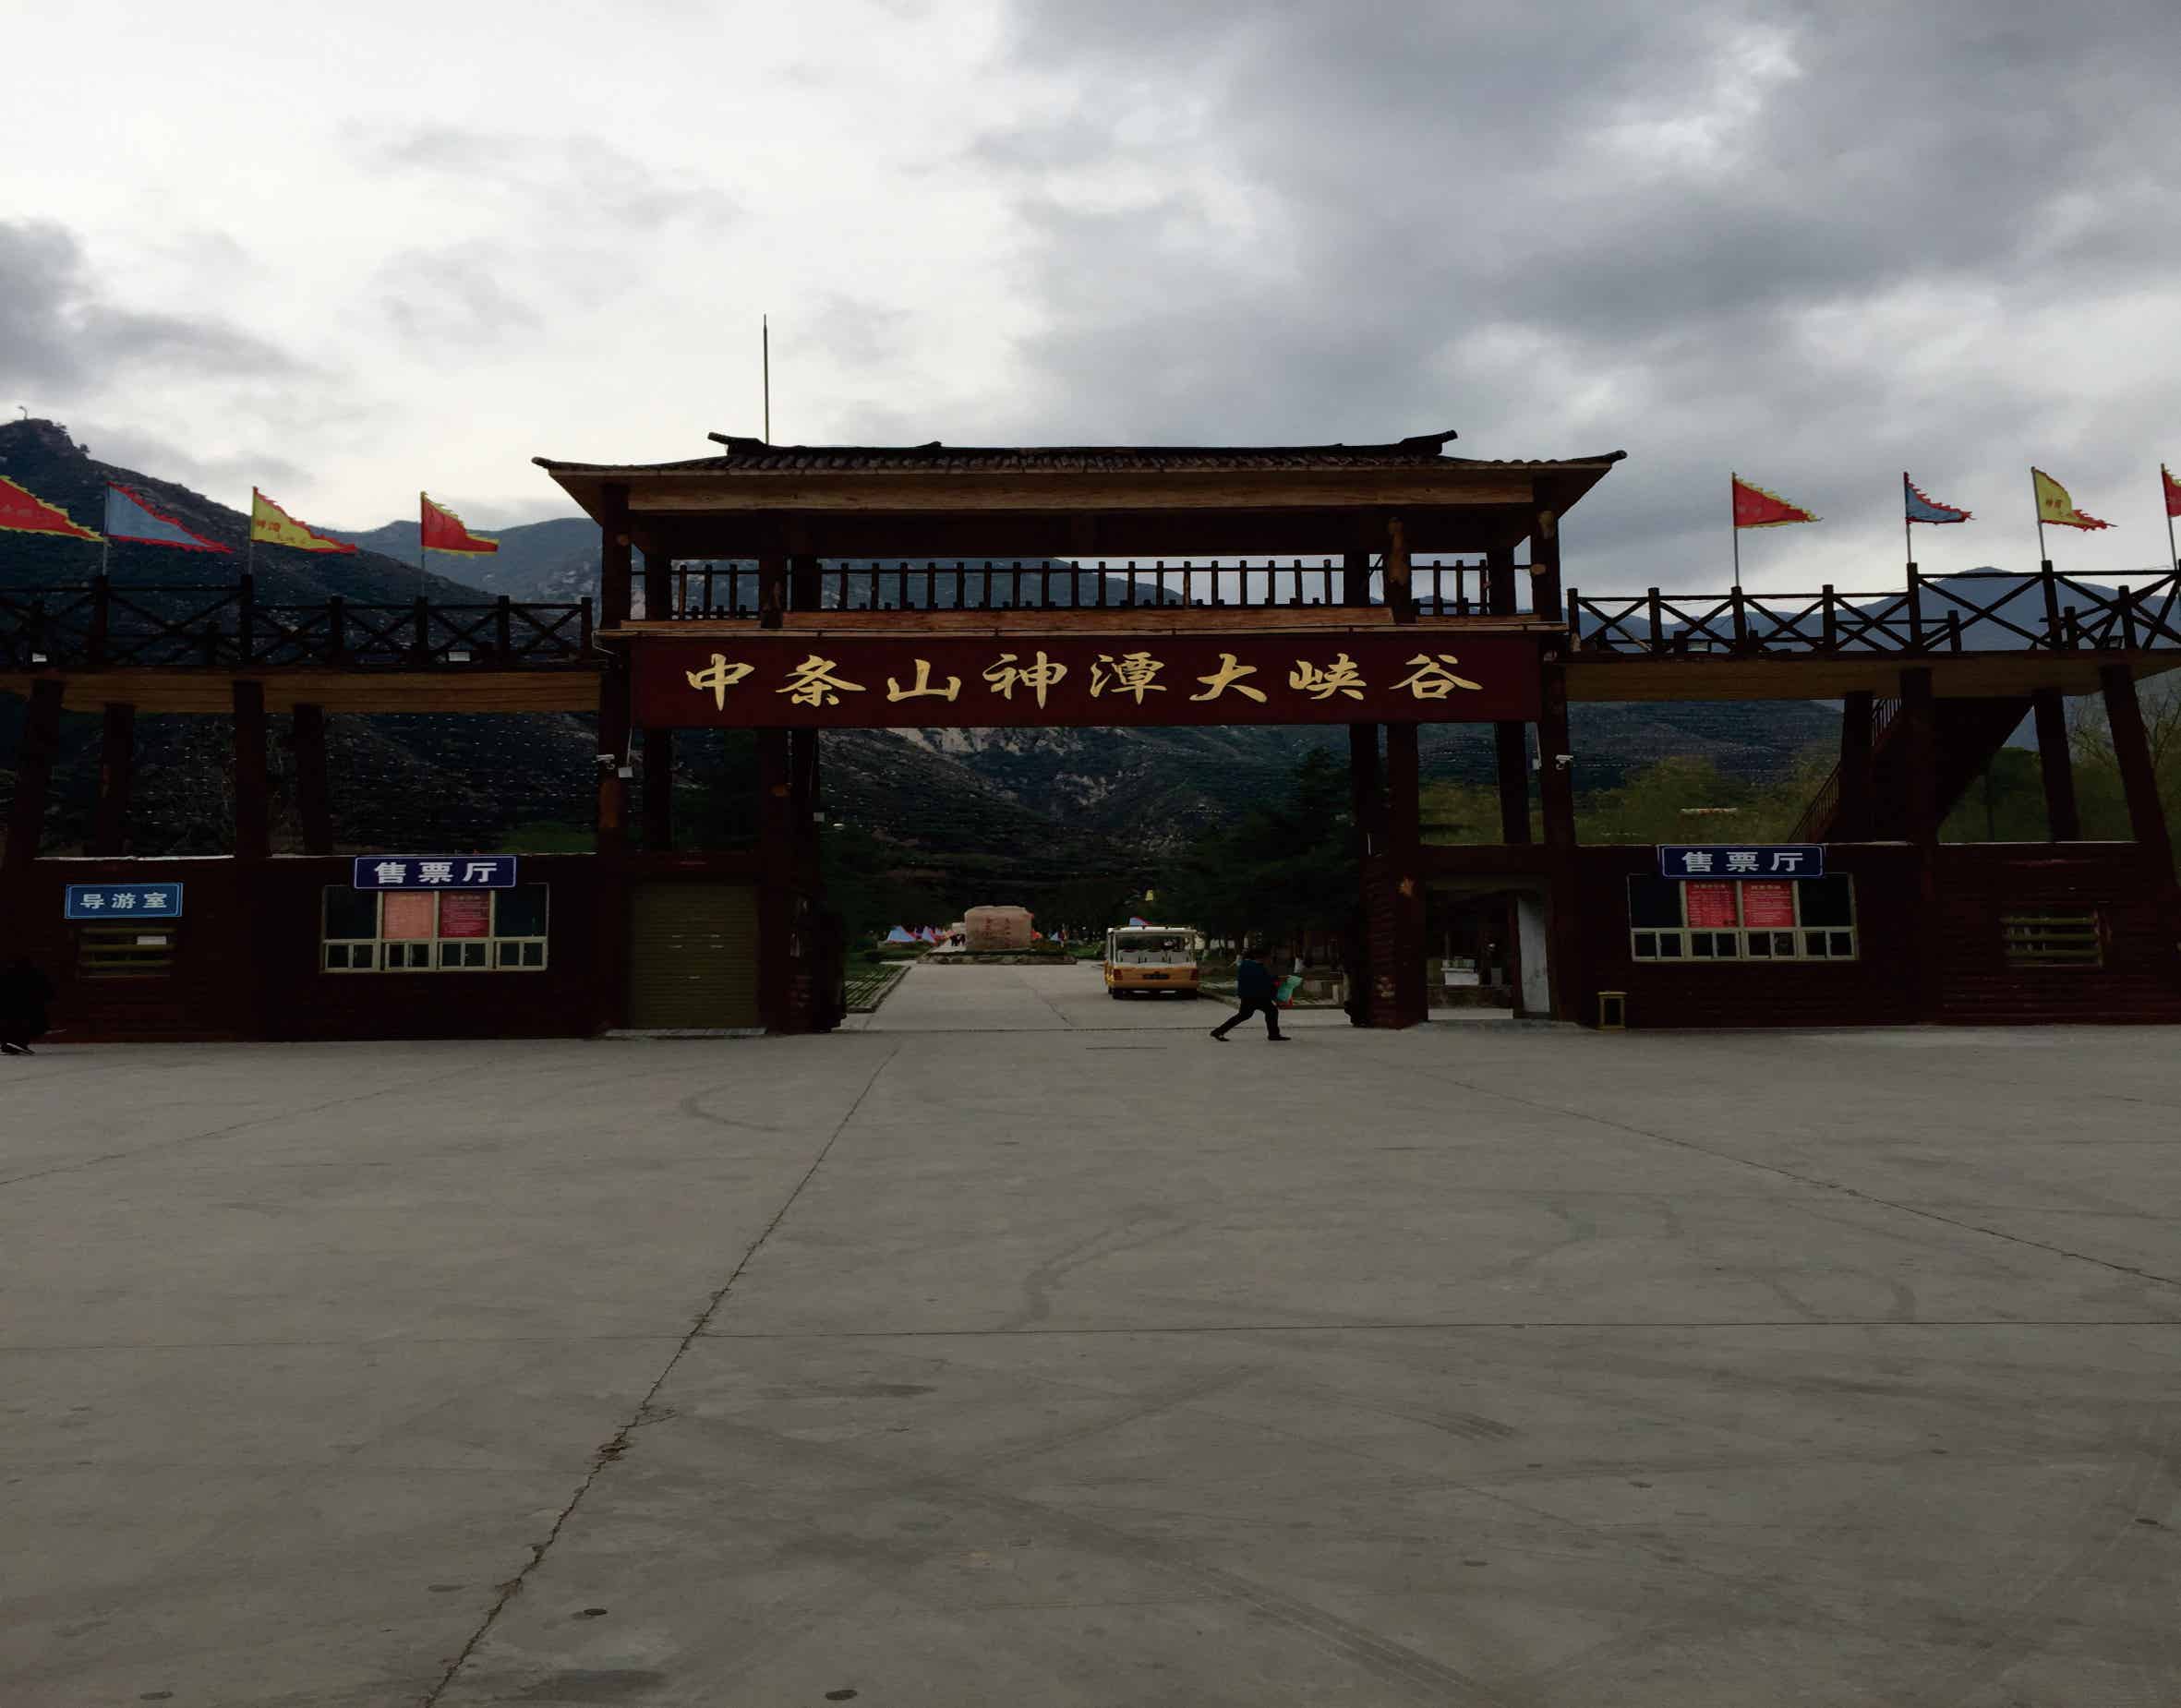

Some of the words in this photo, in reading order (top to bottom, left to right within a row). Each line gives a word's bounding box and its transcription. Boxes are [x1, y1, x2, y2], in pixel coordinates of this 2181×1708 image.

[685, 652, 1483, 711] 中条山神潭大峡谷
[375, 861, 498, 884] 售票厅
[1681, 851, 1803, 872] 售票厅
[80, 892, 168, 909] 导游室
